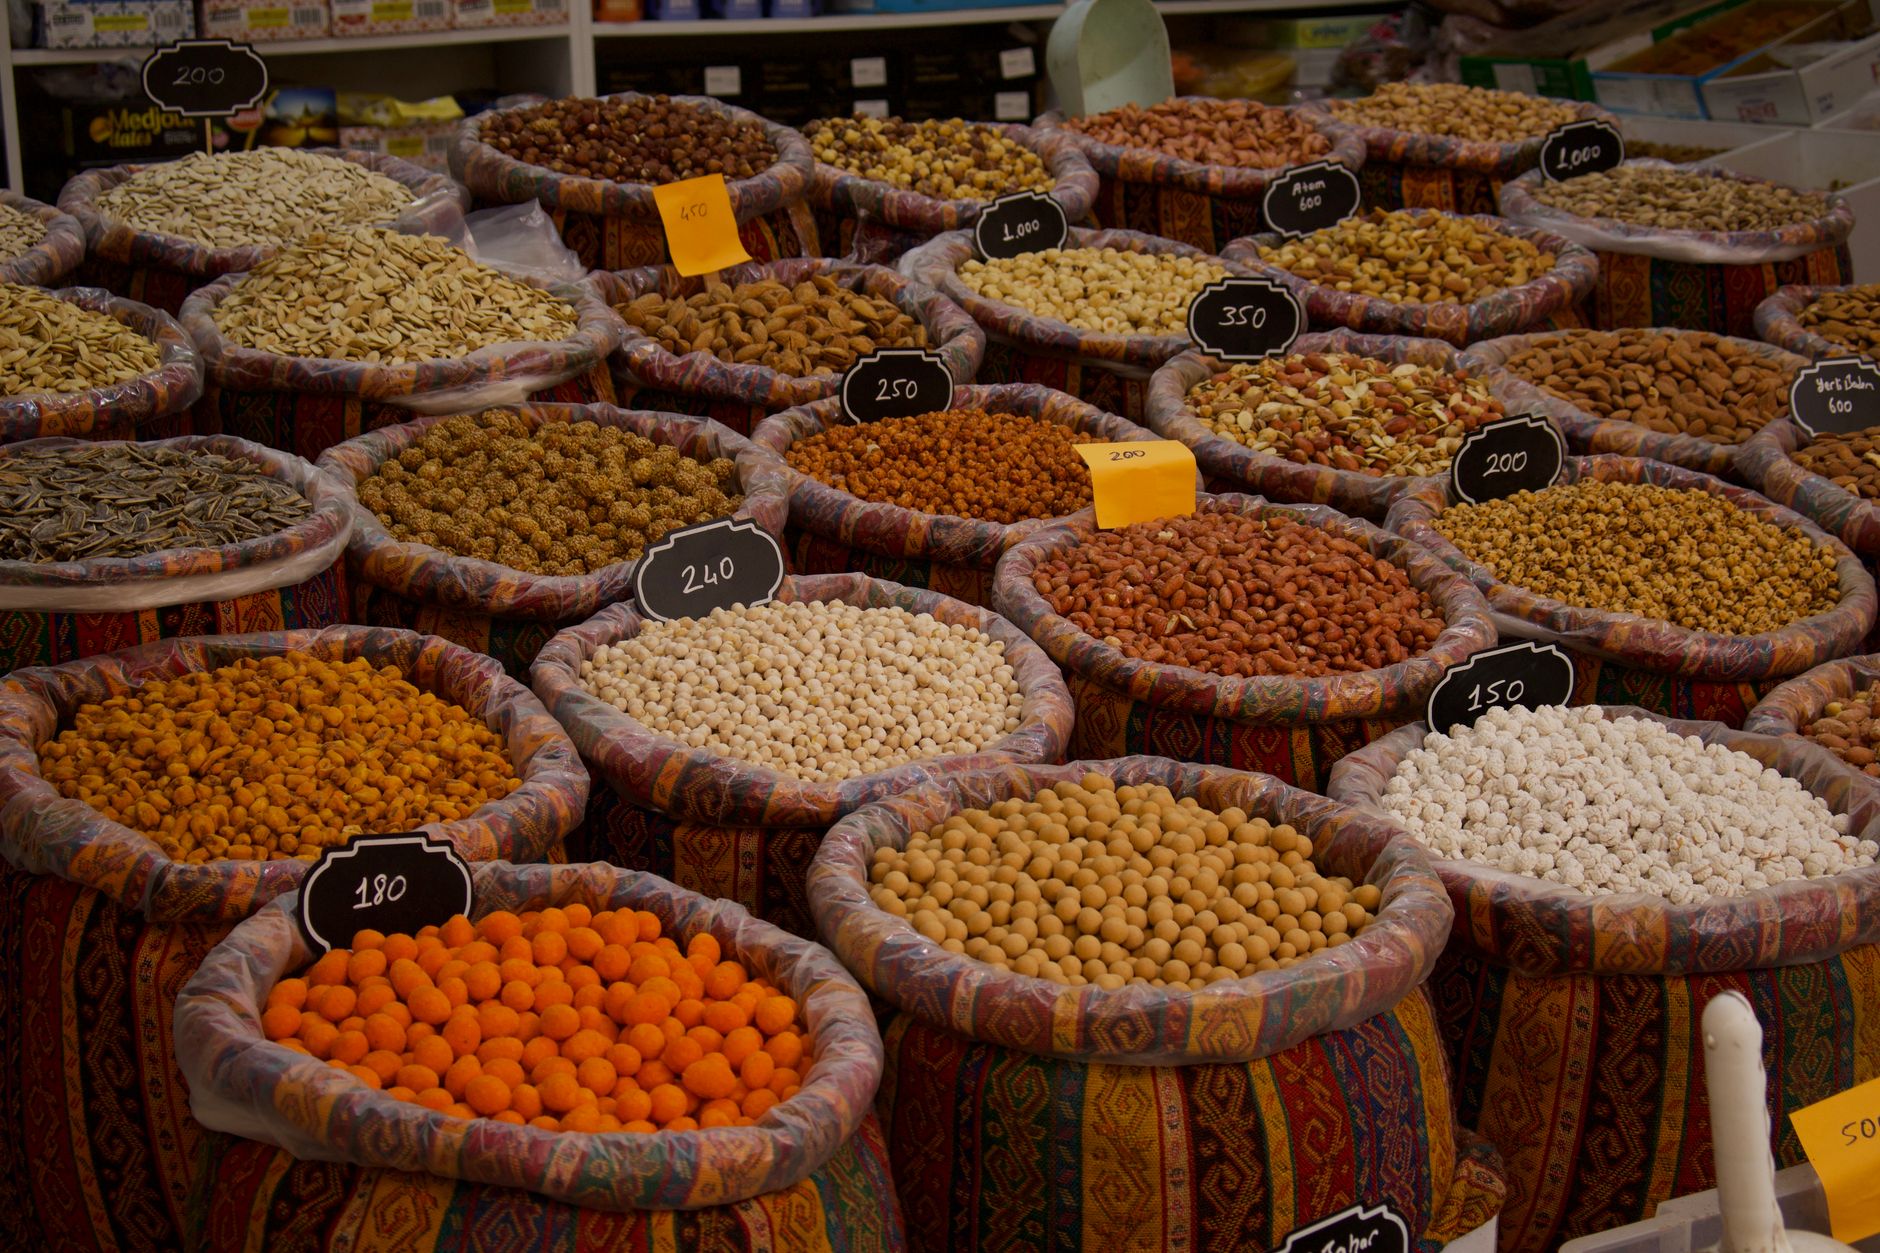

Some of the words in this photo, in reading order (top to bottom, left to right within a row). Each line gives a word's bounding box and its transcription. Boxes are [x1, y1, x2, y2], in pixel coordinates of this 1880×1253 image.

[172, 65, 225, 86] 200
[681, 203, 708, 220] 450
[1299, 195, 1322, 212] 600
[1003, 219, 1040, 241] 1.000
[1218, 304, 1266, 329] 350
[875, 378, 918, 401] 250
[1829, 397, 1852, 414] 600
[1109, 449, 1146, 461] 200
[1482, 451, 1527, 477] 200
[681, 556, 734, 594] 240
[1467, 679, 1524, 711] 150
[352, 873, 407, 910] 180
[1841, 1115, 1880, 1147] 50
